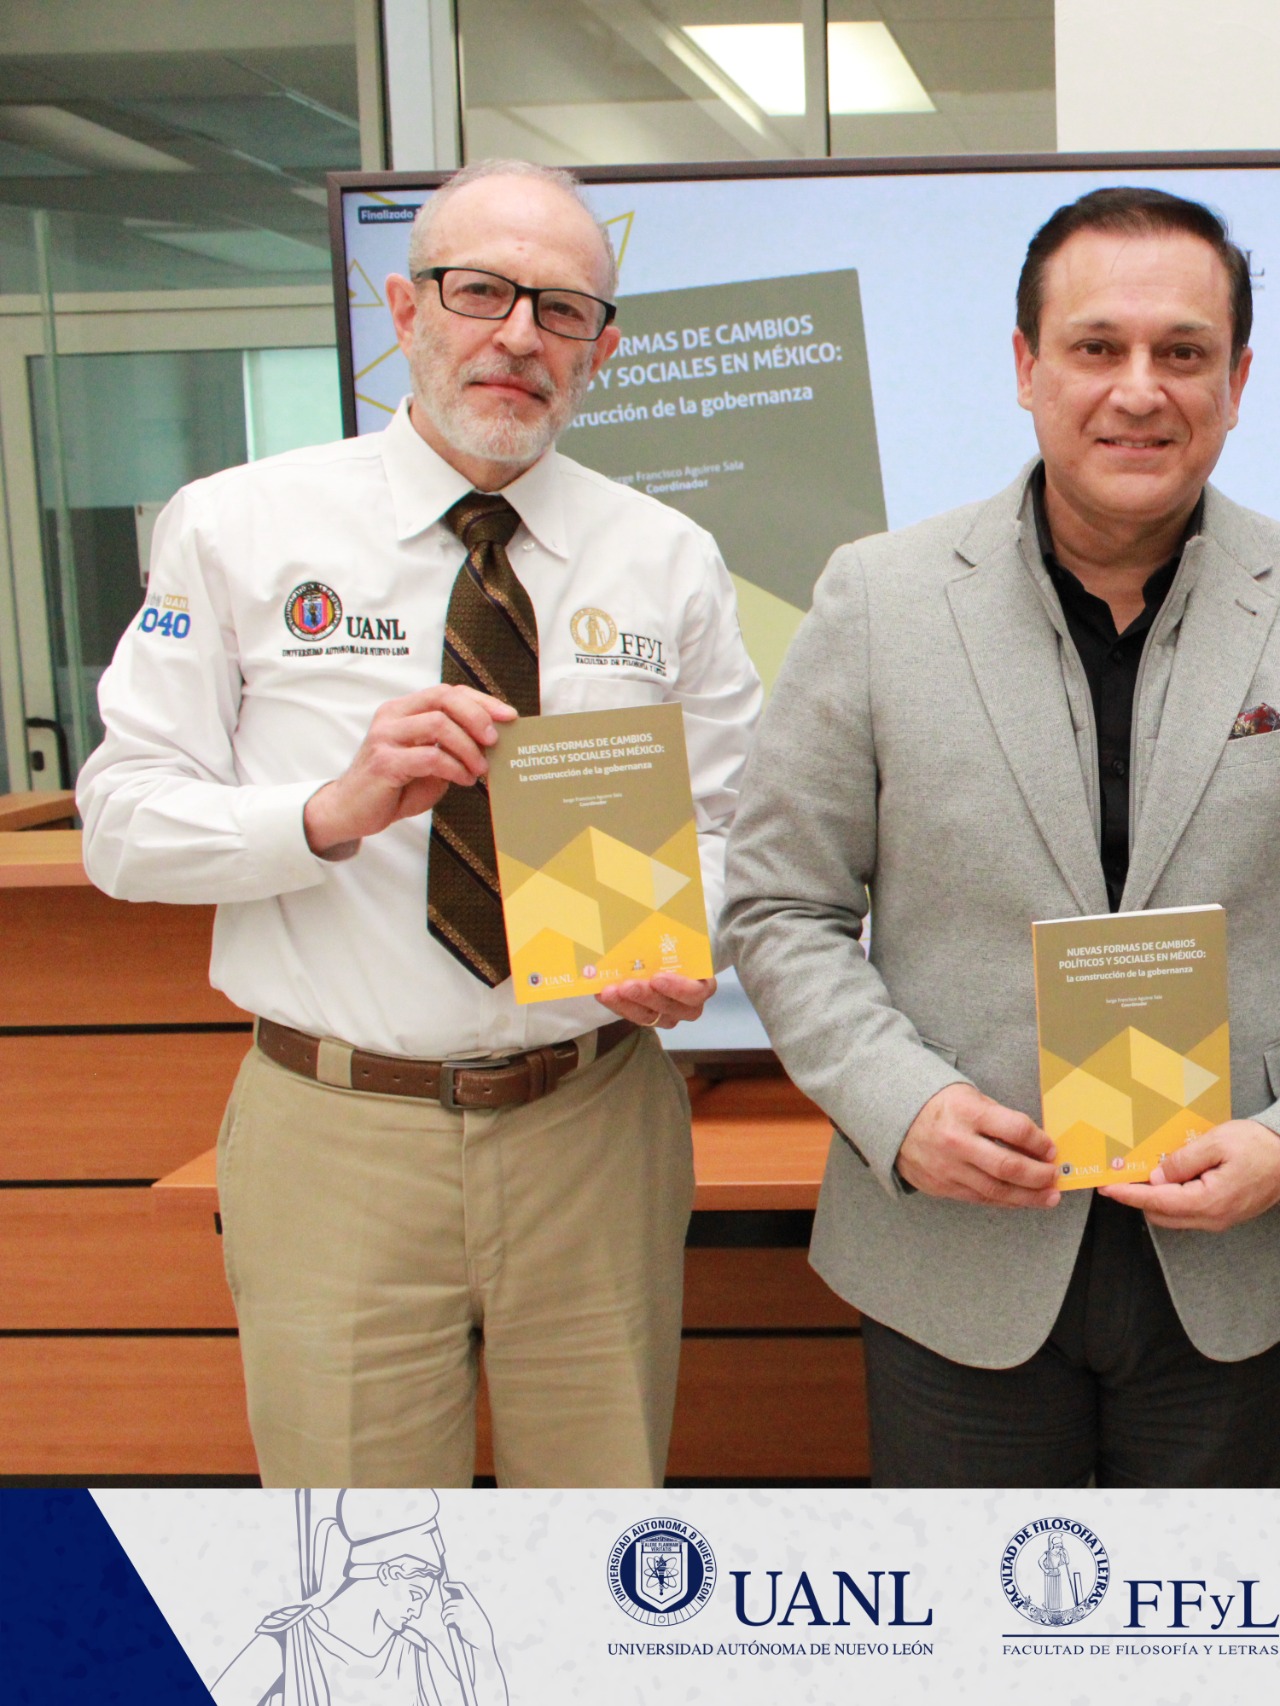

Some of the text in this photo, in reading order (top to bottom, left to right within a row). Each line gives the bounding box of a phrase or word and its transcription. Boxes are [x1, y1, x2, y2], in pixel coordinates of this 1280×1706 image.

[362, 209, 413, 220] Finalizado
[610, 315, 813, 358] RMAS DE CAMBIOS
[598, 370, 612, 389] Y
[616, 356, 717, 387] SOCIALES
[722, 352, 749, 375] EN
[754, 342, 842, 370] MÉXICO:
[567, 386, 813, 428] trucción de la gobernanza
[636, 468, 682, 481] Francisco
[685, 464, 720, 477] Aguirre
[646, 480, 708, 494] Coordinador
[137, 608, 191, 639] 040
[346, 616, 406, 640] UANL
[282, 647, 323, 657] UNIVERSIDAD
[576, 657, 608, 665] FACULTAD
[518, 733, 653, 755] NUEVAS FORMAS DE CAMBIOS
[510, 745, 665, 769] POLÍTICOS Y SOCIALES EN MÉXICO:
[519, 761, 652, 782] la construcción de la gobernanza
[1067, 939, 1195, 957] NUEVAS FORMAS DE CAMBIOS
[1059, 950, 1206, 969] POLÍTICOS Y SOCIALES EN MÉXICO:
[544, 973, 574, 985] UANL
[1067, 966, 1193, 983] la construcción de la gobernanza
